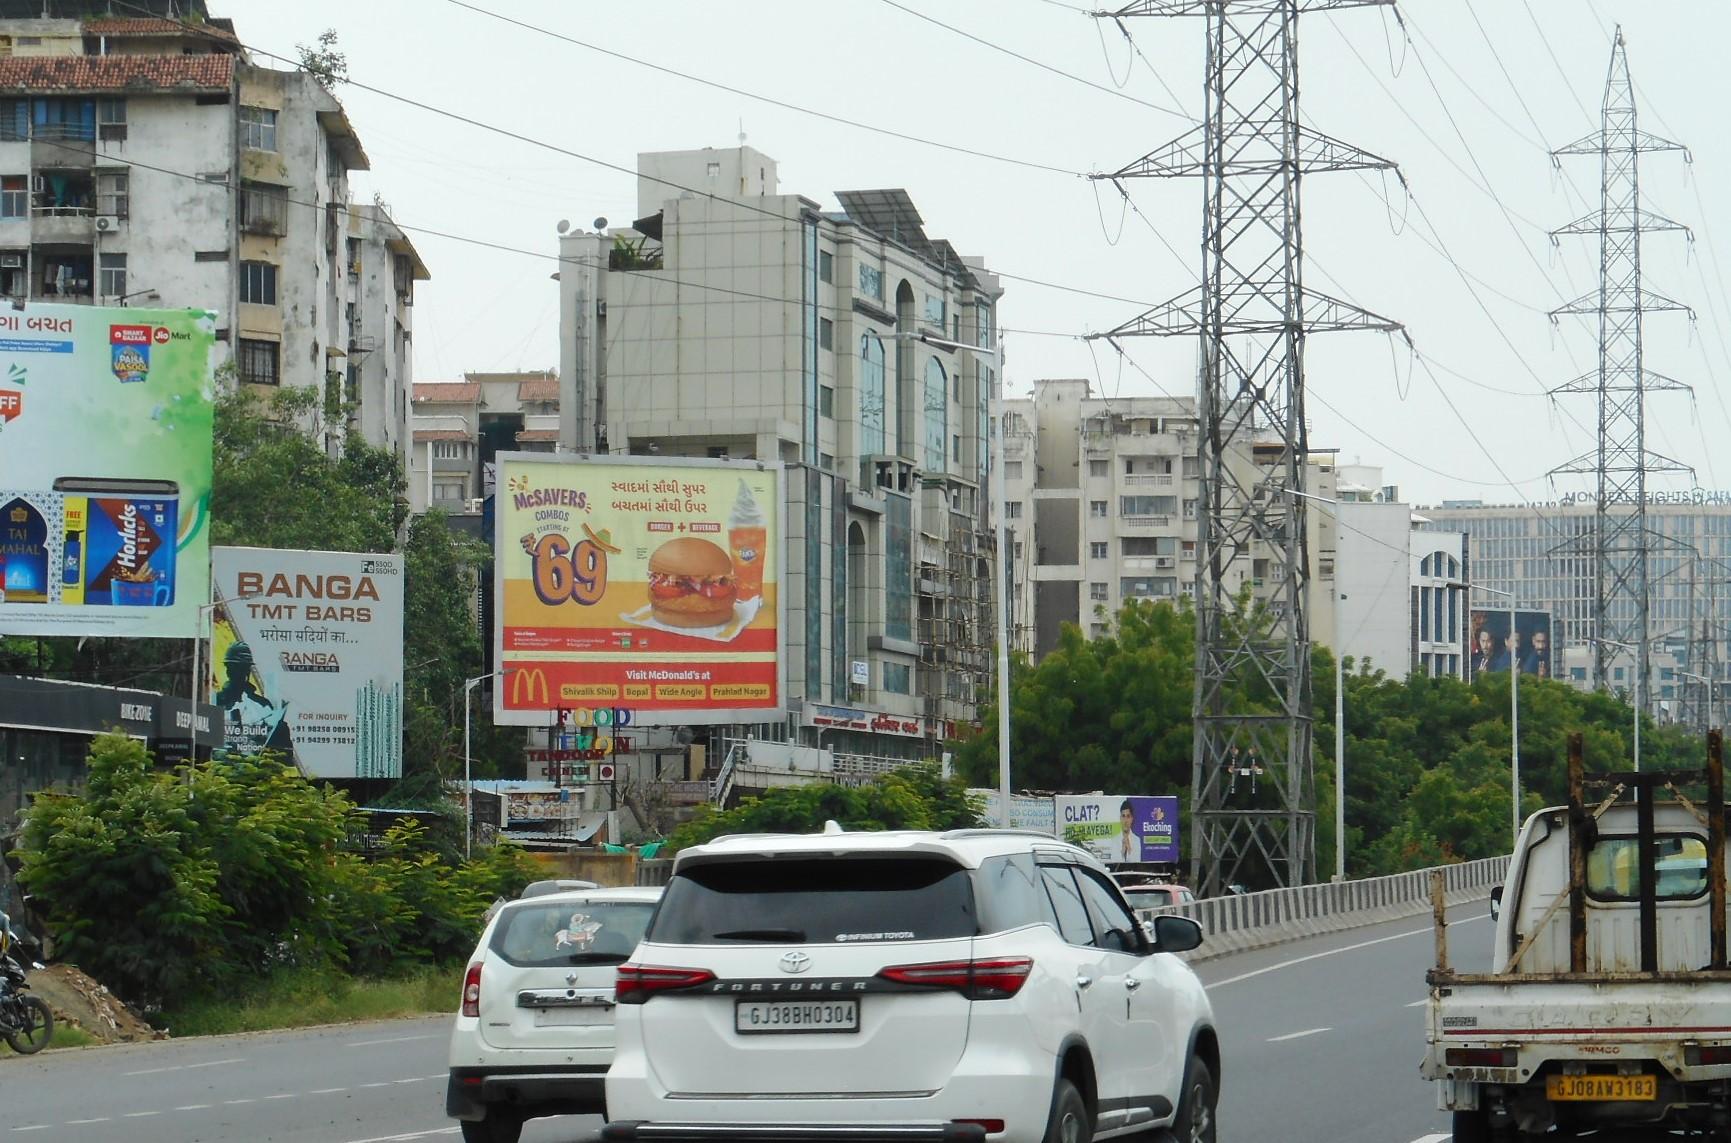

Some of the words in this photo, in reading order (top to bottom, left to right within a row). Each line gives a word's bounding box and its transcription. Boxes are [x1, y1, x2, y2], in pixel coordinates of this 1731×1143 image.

[27, 317, 73, 333] બચત
[155, 331, 169, 340] Jio
[171, 331, 191, 340] Mart
[611, 480, 650, 494] સ્વાદમાં
[652, 479, 679, 495] સૌથી
[682, 483, 706, 498] સુપર
[513, 488, 587, 512] McSAVERS
[611, 498, 652, 512] બચતમાં
[655, 498, 682, 513] સૌથી
[684, 500, 708, 513] ઉપર
[535, 509, 570, 522] COMBOS
[116, 503, 137, 568] Horlicks
[531, 533, 608, 606] 69
[238, 571, 380, 601] BANGA
[246, 603, 297, 620] TMT
[305, 605, 372, 622] BARS
[259, 624, 291, 642] भरोसा
[294, 625, 328, 645] सदियों
[625, 670, 647, 680] Visit
[649, 671, 700, 680] McDonald's
[702, 672, 711, 681] at
[563, 687, 594, 697] Shivalik
[596, 687, 617, 698] Shilp
[626, 688, 649, 698] Bopal
[659, 688, 679, 697] Wide
[680, 688, 703, 698] Angle
[713, 688, 743, 697] Prahlad
[745, 688, 767, 698] Nagar
[298, 713, 313, 721] FOR
[315, 713, 348, 721] INQUIRY
[558, 706, 632, 729] FOOD
[224, 725, 241, 735] We
[242, 725, 268, 736] Build
[223, 735, 249, 744] Strong
[1065, 804, 1100, 822] CLAT?
[713, 982, 867, 991] FORTUNER
[750, 1006, 854, 1025] GJ38BH0304
